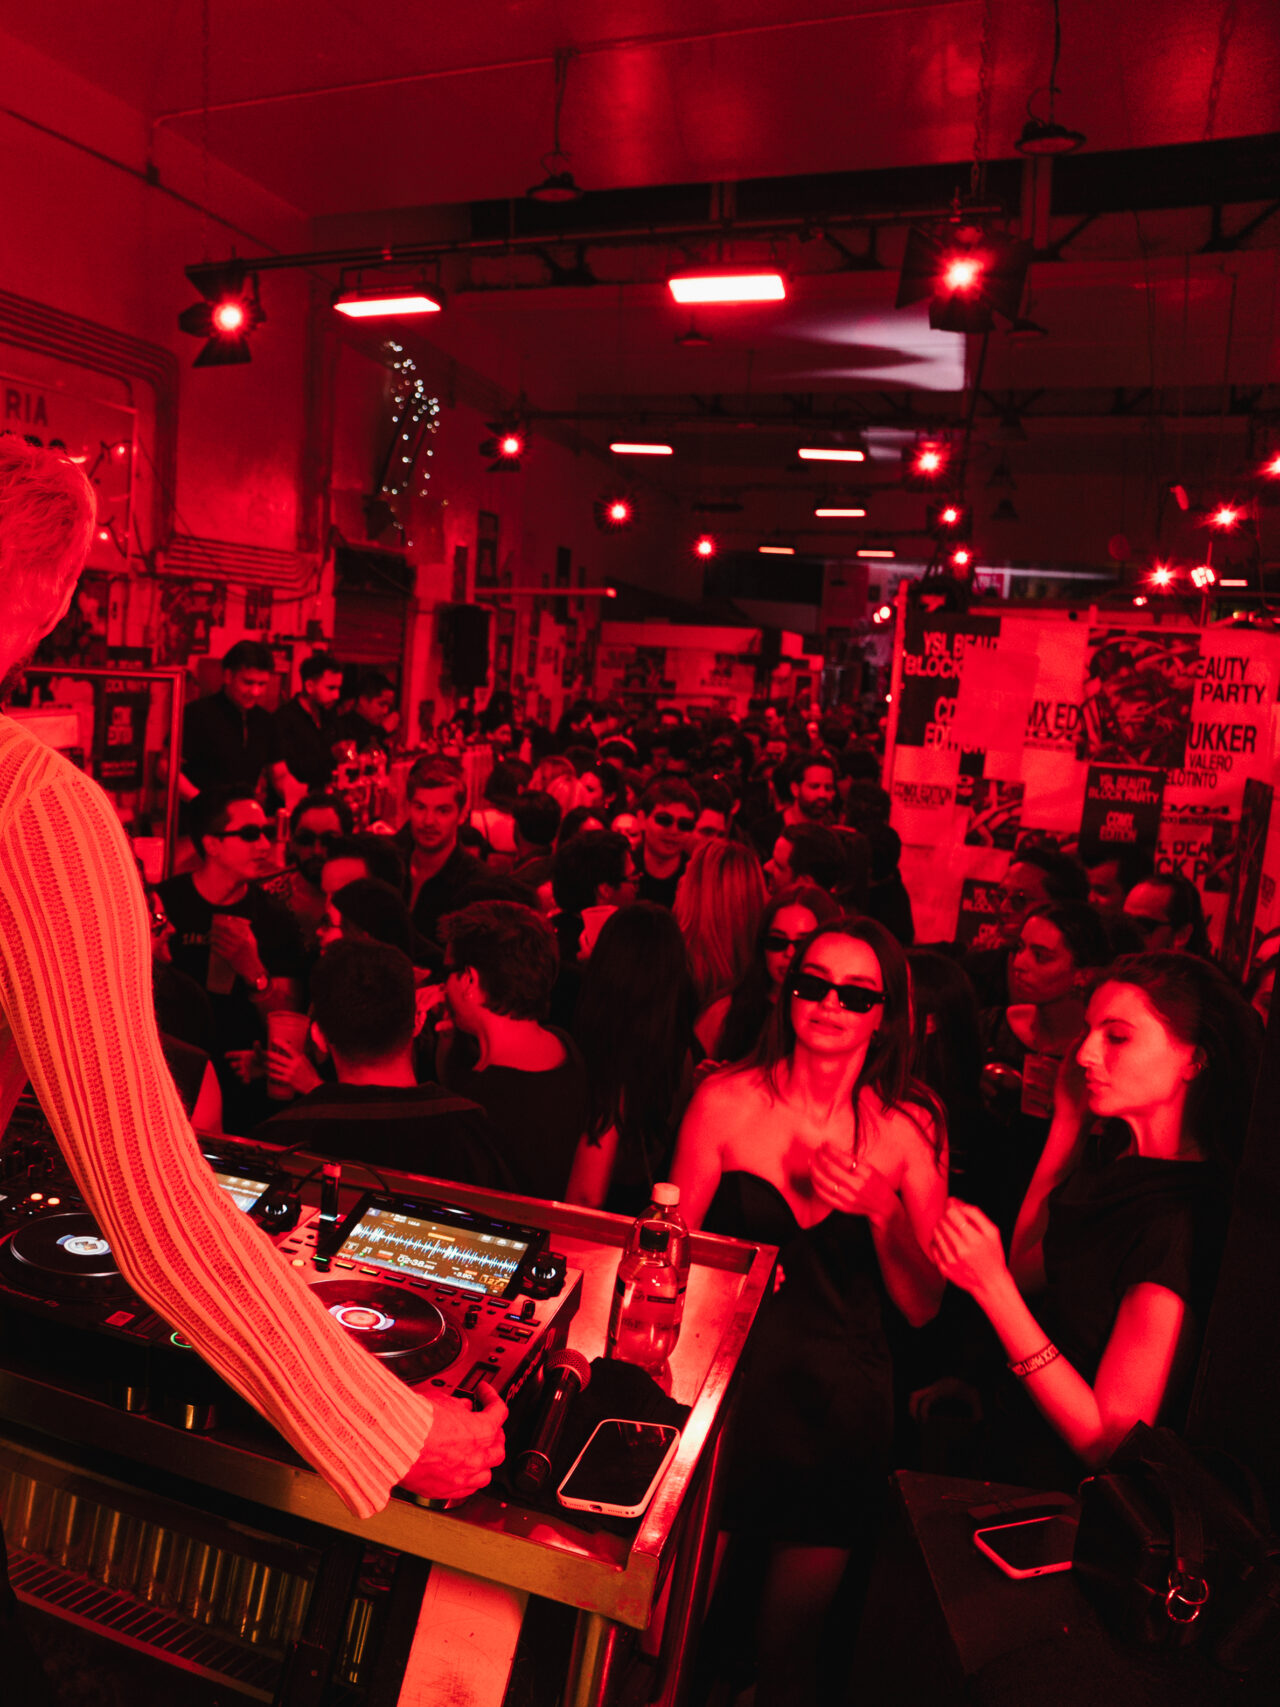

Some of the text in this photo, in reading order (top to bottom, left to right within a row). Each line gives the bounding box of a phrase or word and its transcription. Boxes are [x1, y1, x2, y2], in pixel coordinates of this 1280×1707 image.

[923, 631, 950, 659] YSL
[1195, 655, 1249, 681] EAUTY
[1200, 682, 1266, 704] PARTY
[1188, 721, 1257, 753] UKKER
[1189, 754, 1233, 772] VALERO
